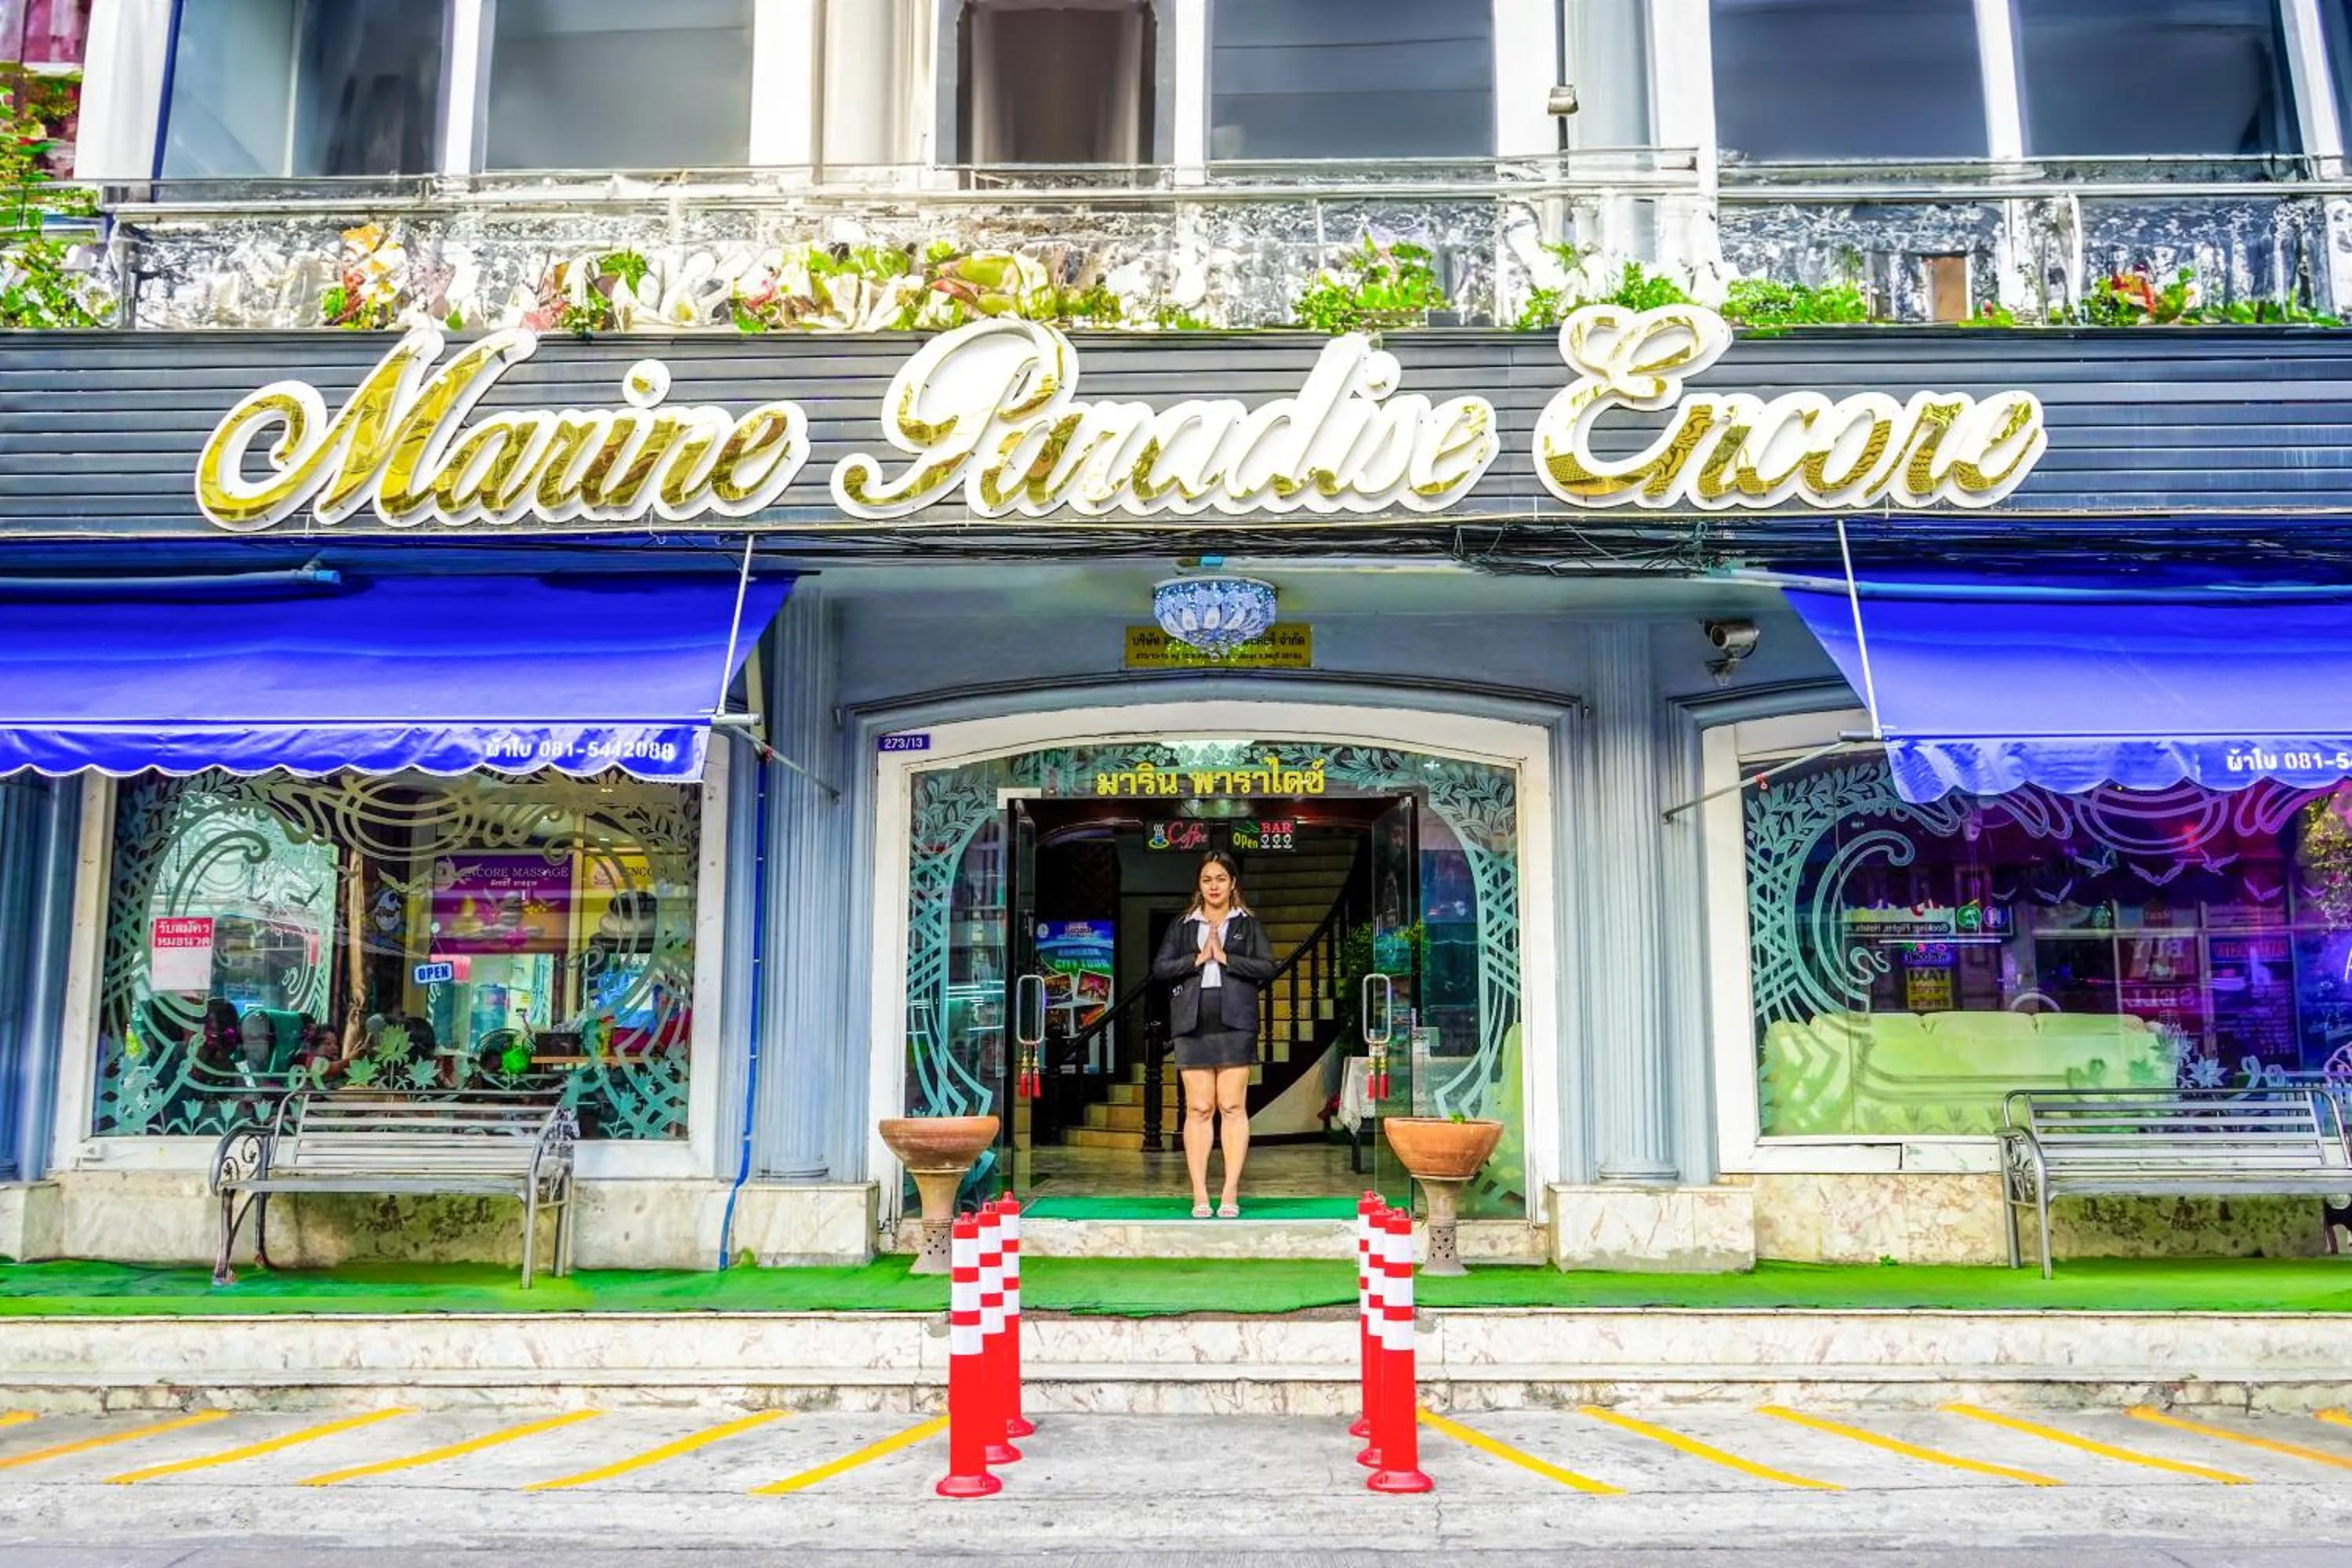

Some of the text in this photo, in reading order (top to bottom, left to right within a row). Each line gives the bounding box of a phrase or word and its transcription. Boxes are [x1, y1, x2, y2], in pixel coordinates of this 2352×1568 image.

[194, 303, 2049, 532] Marine Paradise Encore
[539, 740, 676, 762] 081-5442088
[884, 738, 923, 750] 273/13
[2227, 747, 2352, 772] ผ้าใบ 081-5
[1096, 757, 1327, 795] มาริน พาราไดซ์
[1167, 821, 1209, 850] Coffee
[1260, 822, 1294, 833] BAR
[1233, 833, 1258, 849] Open
[512, 867, 569, 877] MASSAGE
[418, 965, 449, 980] OPEN
